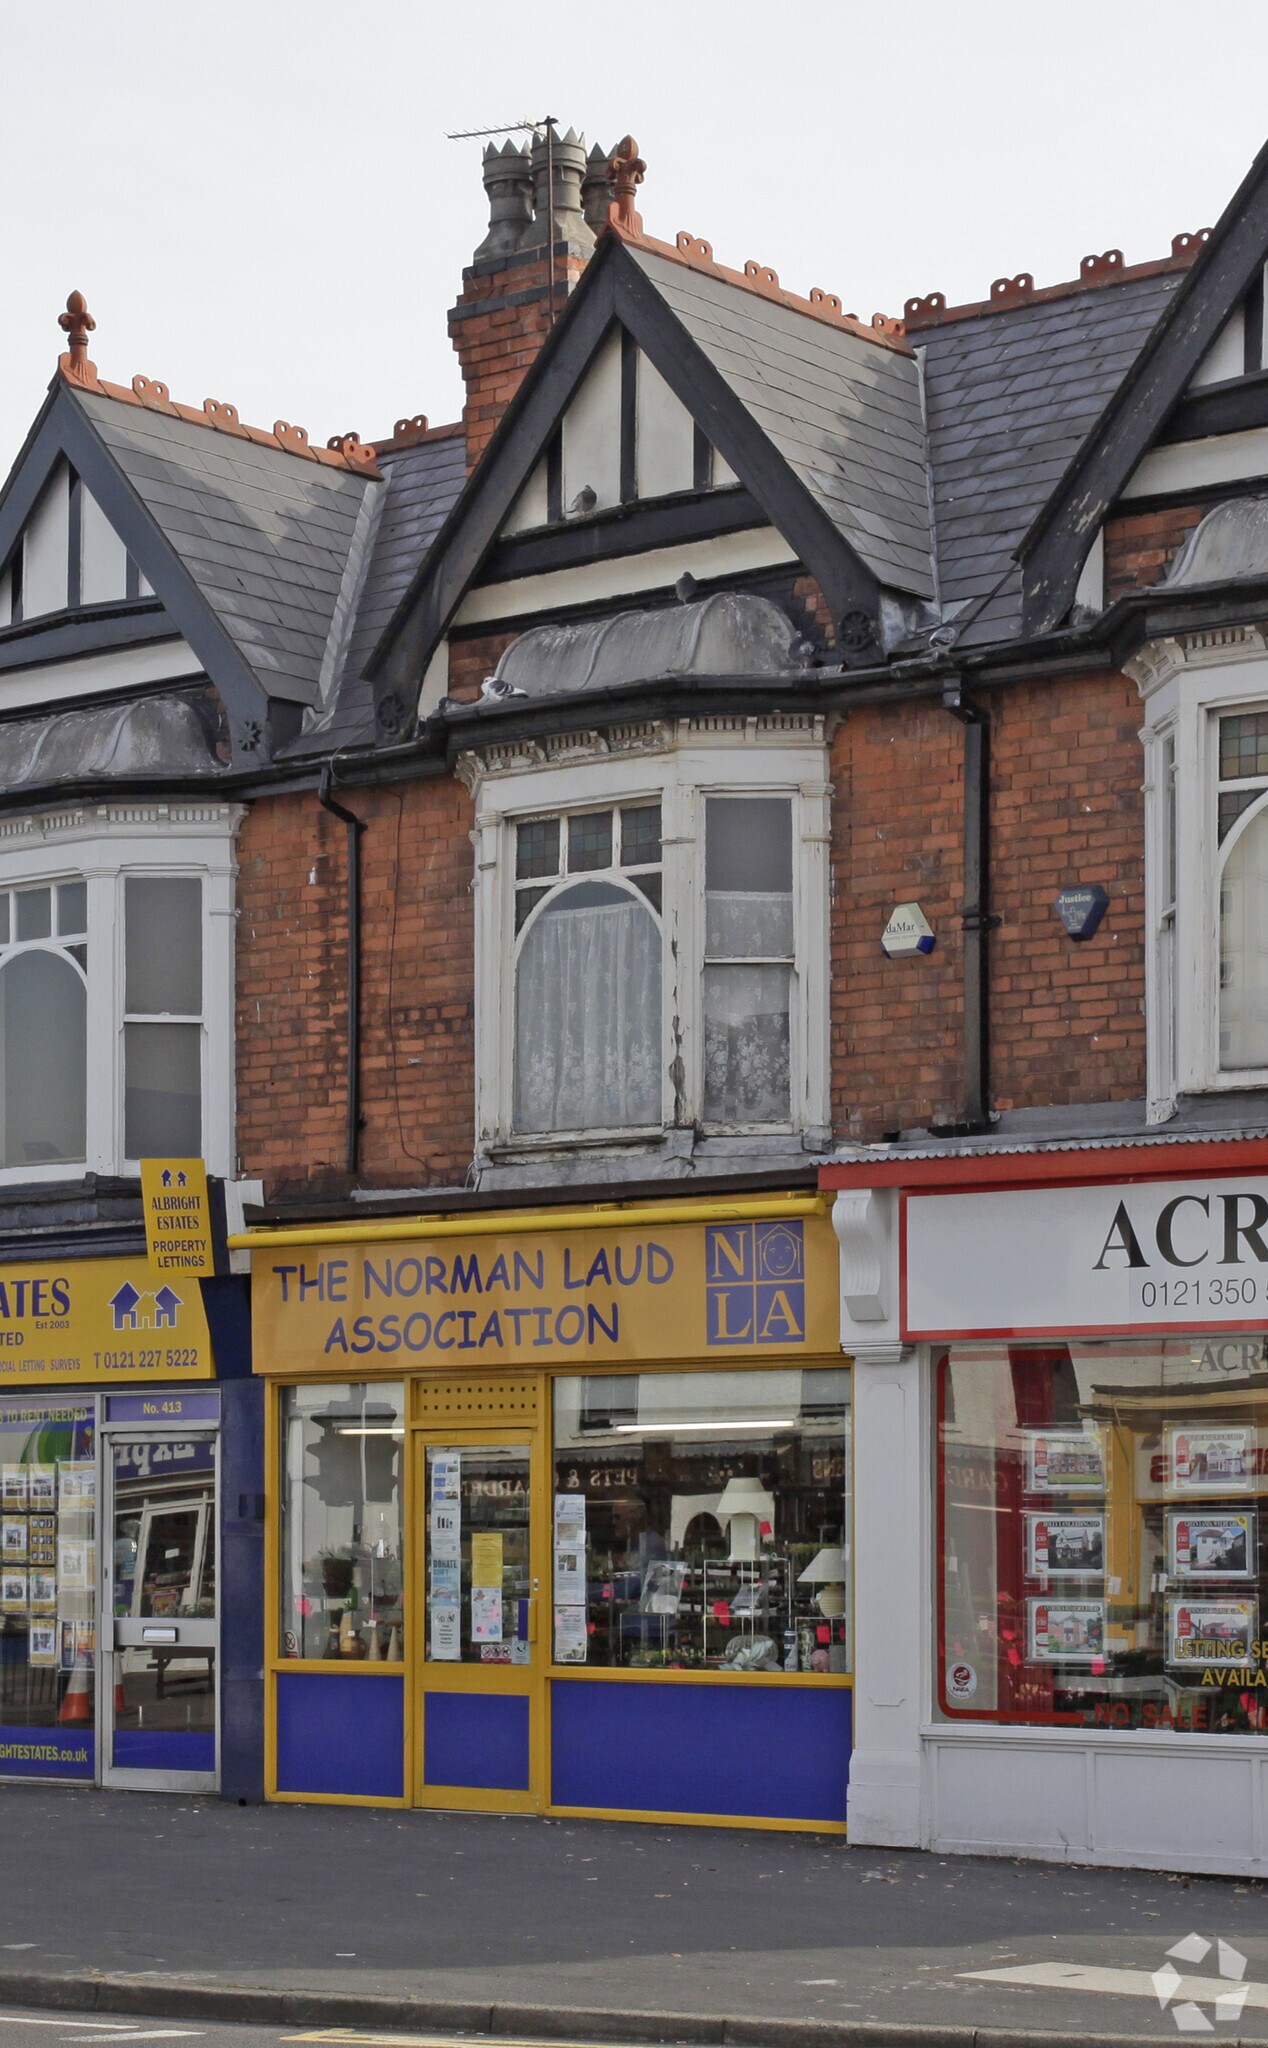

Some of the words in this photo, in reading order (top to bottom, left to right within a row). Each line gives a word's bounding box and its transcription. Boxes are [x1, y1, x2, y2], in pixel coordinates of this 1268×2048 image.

[152, 1195, 201, 1210] ALBRIGHT
[157, 1215, 200, 1230] ESTATES
[1092, 1193, 1268, 1271] ACR
[152, 1240, 207, 1252] PROPERTY
[157, 1255, 205, 1268] LETTINGS
[272, 1260, 349, 1302] THE
[363, 1248, 545, 1300] NORMAN
[563, 1242, 674, 1290] LAUD
[1141, 1280, 1200, 1307] 0121
[1208, 1278, 1257, 1305] 350
[35, 1320, 48, 1330] Est
[50, 1320, 70, 1330] 2003
[324, 1302, 619, 1354] ASSOCIATION
[19, 1359, 46, 1373] LETTING
[50, 1358, 80, 1371] SURVEYS
[94, 1351, 101, 1369] T
[104, 1351, 136, 1369] 0121
[138, 1349, 162, 1368] 227
[166, 1348, 198, 1367] 5222
[6, 1409, 18, 1424] TO
[21, 1408, 46, 1423] RENT
[48, 1406, 88, 1422] NEEDED
[143, 1402, 160, 1415] No.
[161, 1401, 182, 1414] 413
[1175, 1637, 1246, 1660] LETTING
[1094, 1702, 1130, 1727] NO
[1141, 1702, 1208, 1729] SALE
